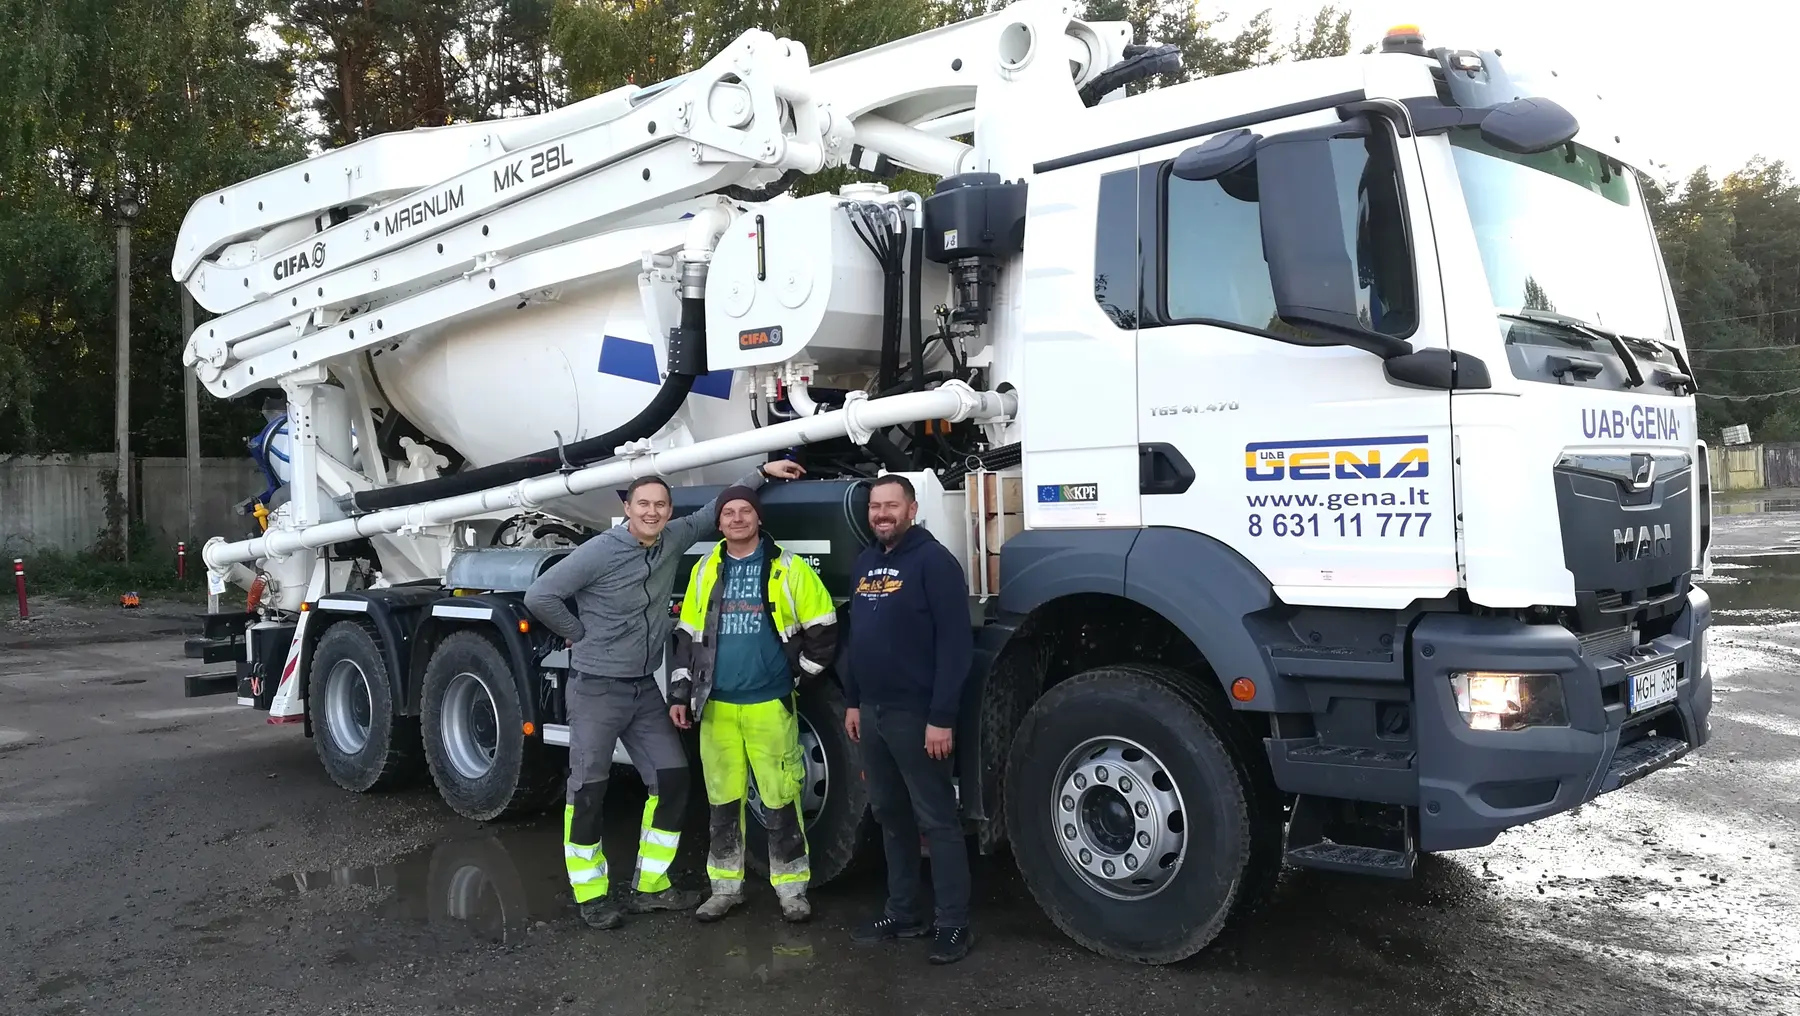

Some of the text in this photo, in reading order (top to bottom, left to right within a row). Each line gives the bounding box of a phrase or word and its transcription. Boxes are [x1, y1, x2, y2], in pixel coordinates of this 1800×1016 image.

[385, 143, 574, 237] MAGNUM MK 28L
[273, 251, 310, 281] CIFA
[740, 332, 769, 346] CIFA
[1245, 435, 1429, 481] GENA
[1260, 451, 1285, 460] UAB
[1074, 485, 1096, 500] KPF
[1246, 487, 1430, 511] www.gena.lt
[1248, 512, 1432, 537] 8 631 11 777
[1613, 523, 1671, 563] MAN
[1635, 674, 1656, 702] MGH
[1661, 667, 1675, 693] 385
